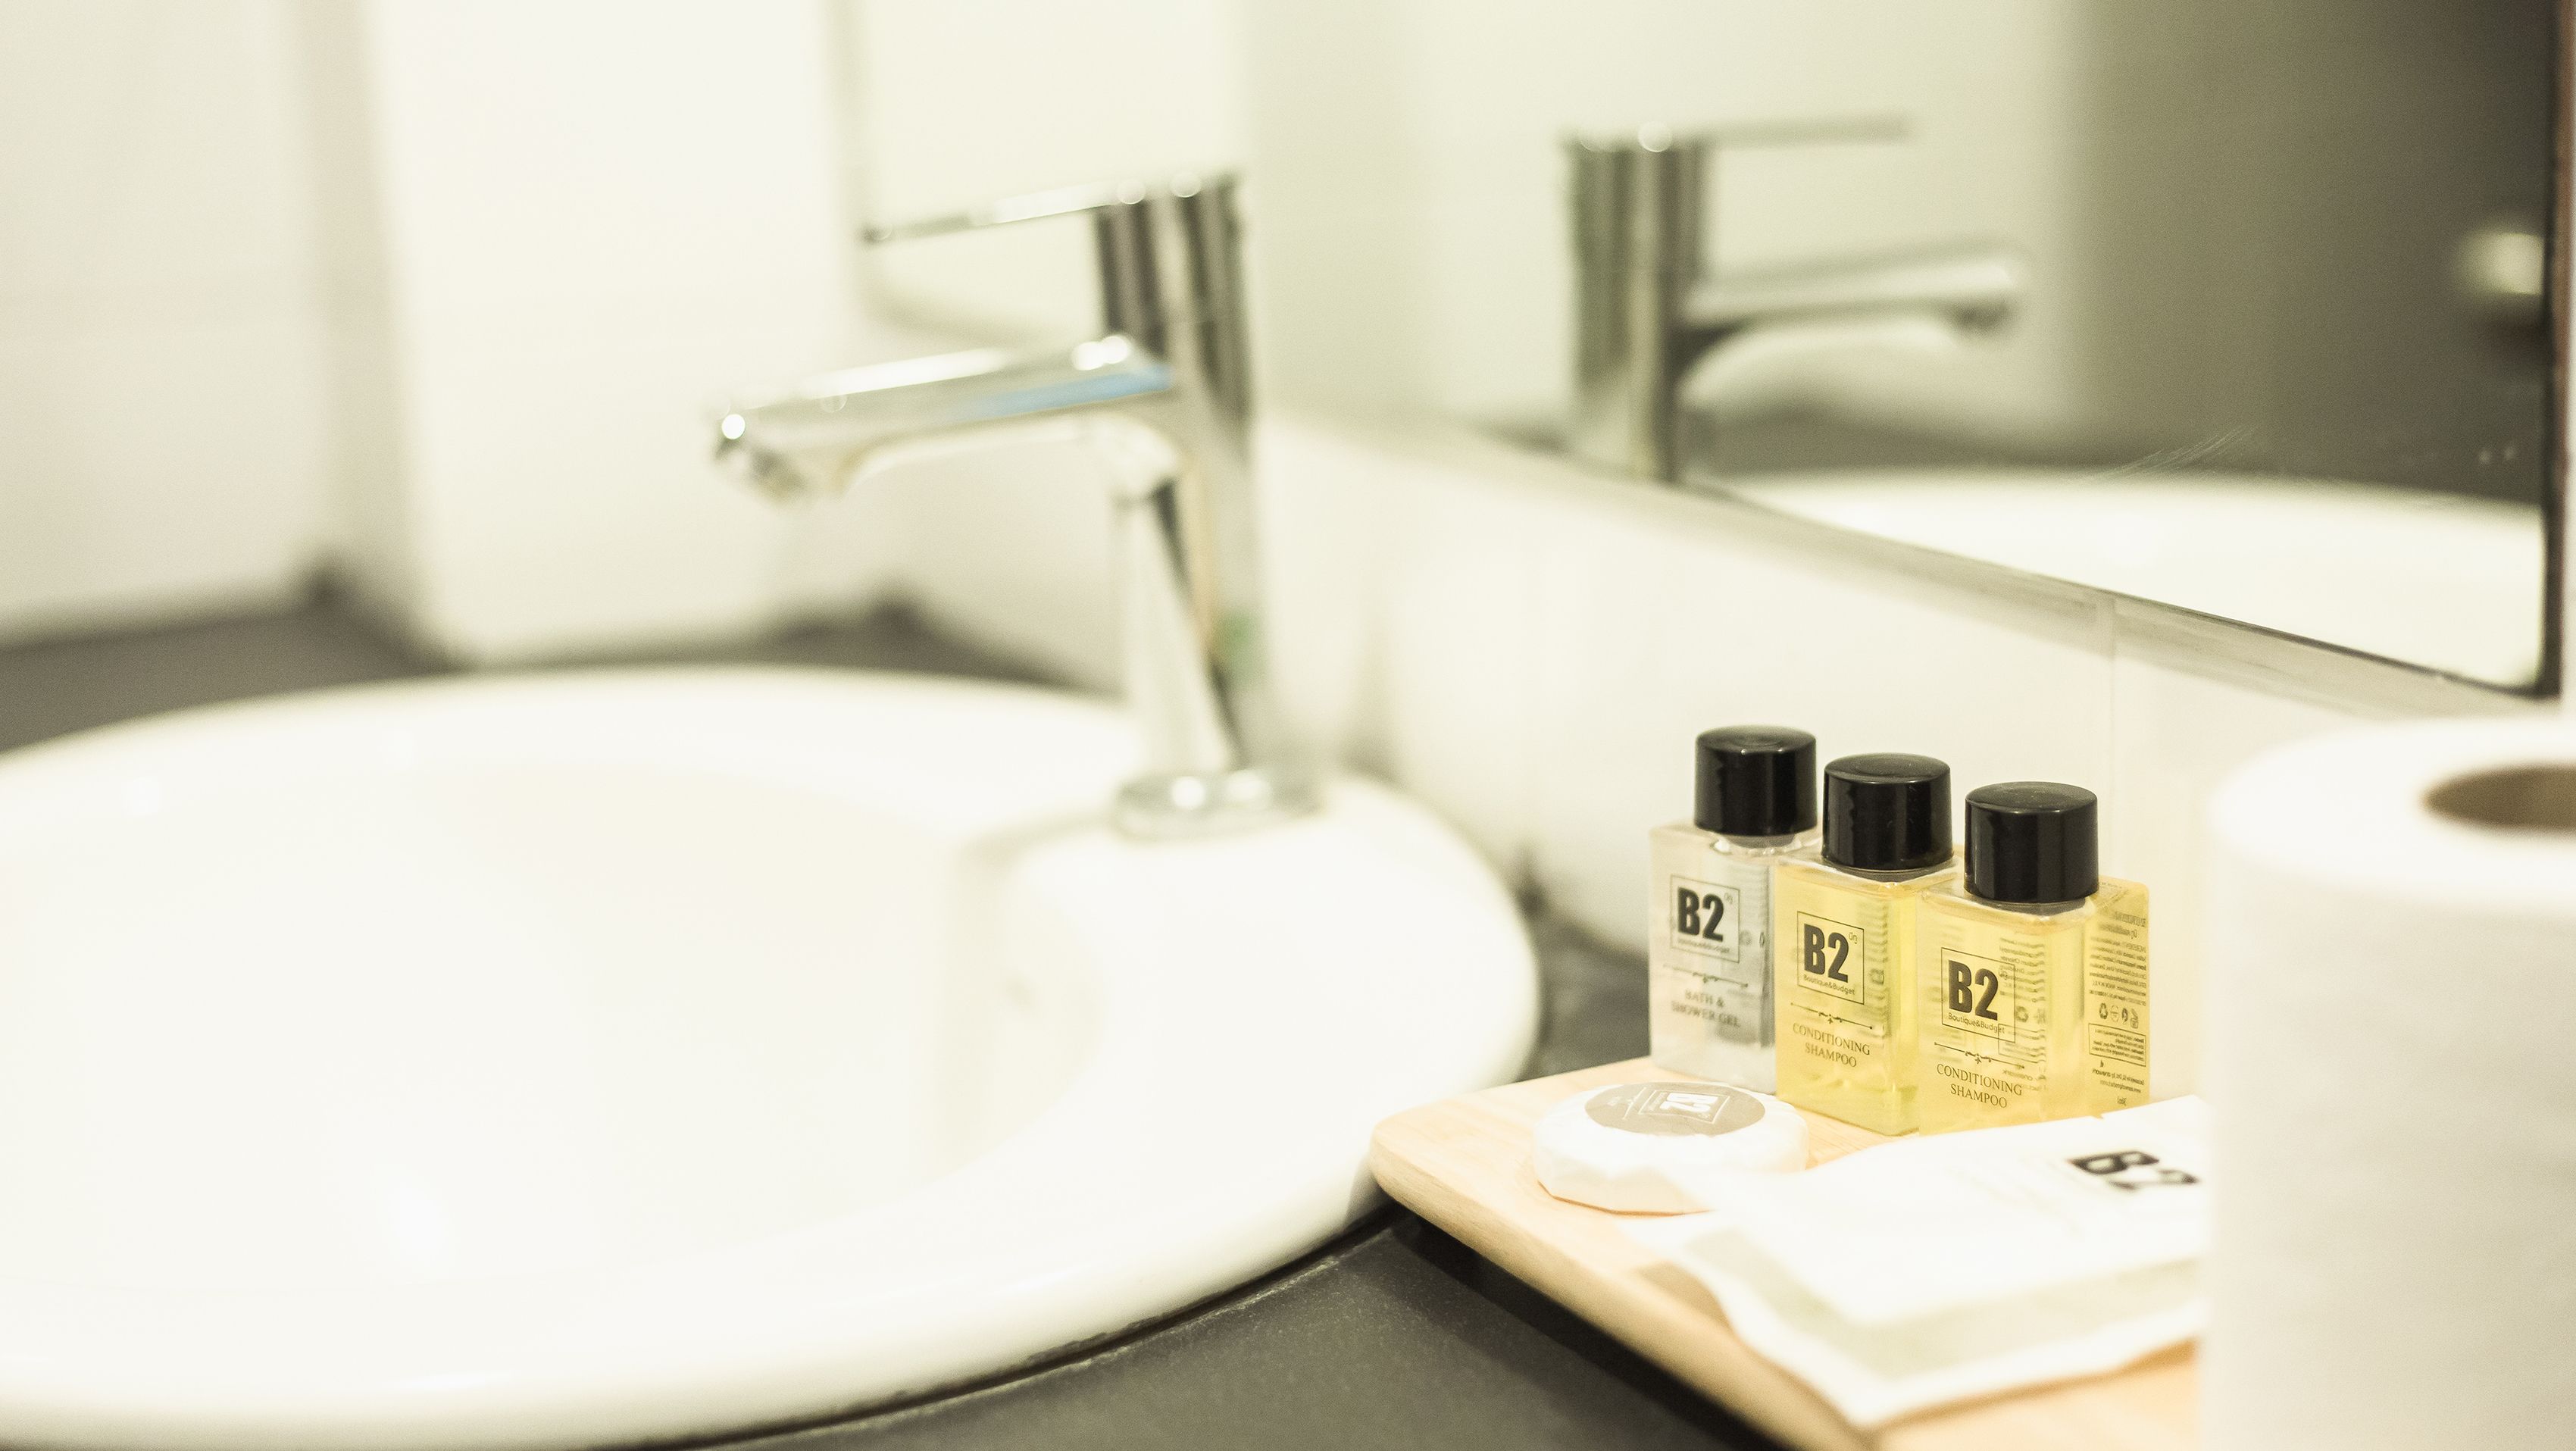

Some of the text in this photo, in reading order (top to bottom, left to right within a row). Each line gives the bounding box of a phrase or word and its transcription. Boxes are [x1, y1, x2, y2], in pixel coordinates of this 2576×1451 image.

[1677, 887, 1724, 943] B2
[1803, 923, 1849, 983] B2
[1803, 974, 1855, 995] Boutique&Budget
[1948, 959, 1999, 1021] B2
[1685, 989, 1726, 1009] BATH &
[1671, 1000, 1740, 1028] SHOWER GEL
[1948, 1012, 2005, 1034] Boutique&Budget
[1793, 1022, 1871, 1056] CONDITIONING
[1804, 1042, 1858, 1068] SHAMPOO
[1937, 1062, 2023, 1096] CONDITIONING
[1658, 1092, 1719, 1113] B2
[1950, 1083, 2008, 1109] SHAMPOO
[2066, 1149, 2200, 1192] B2
